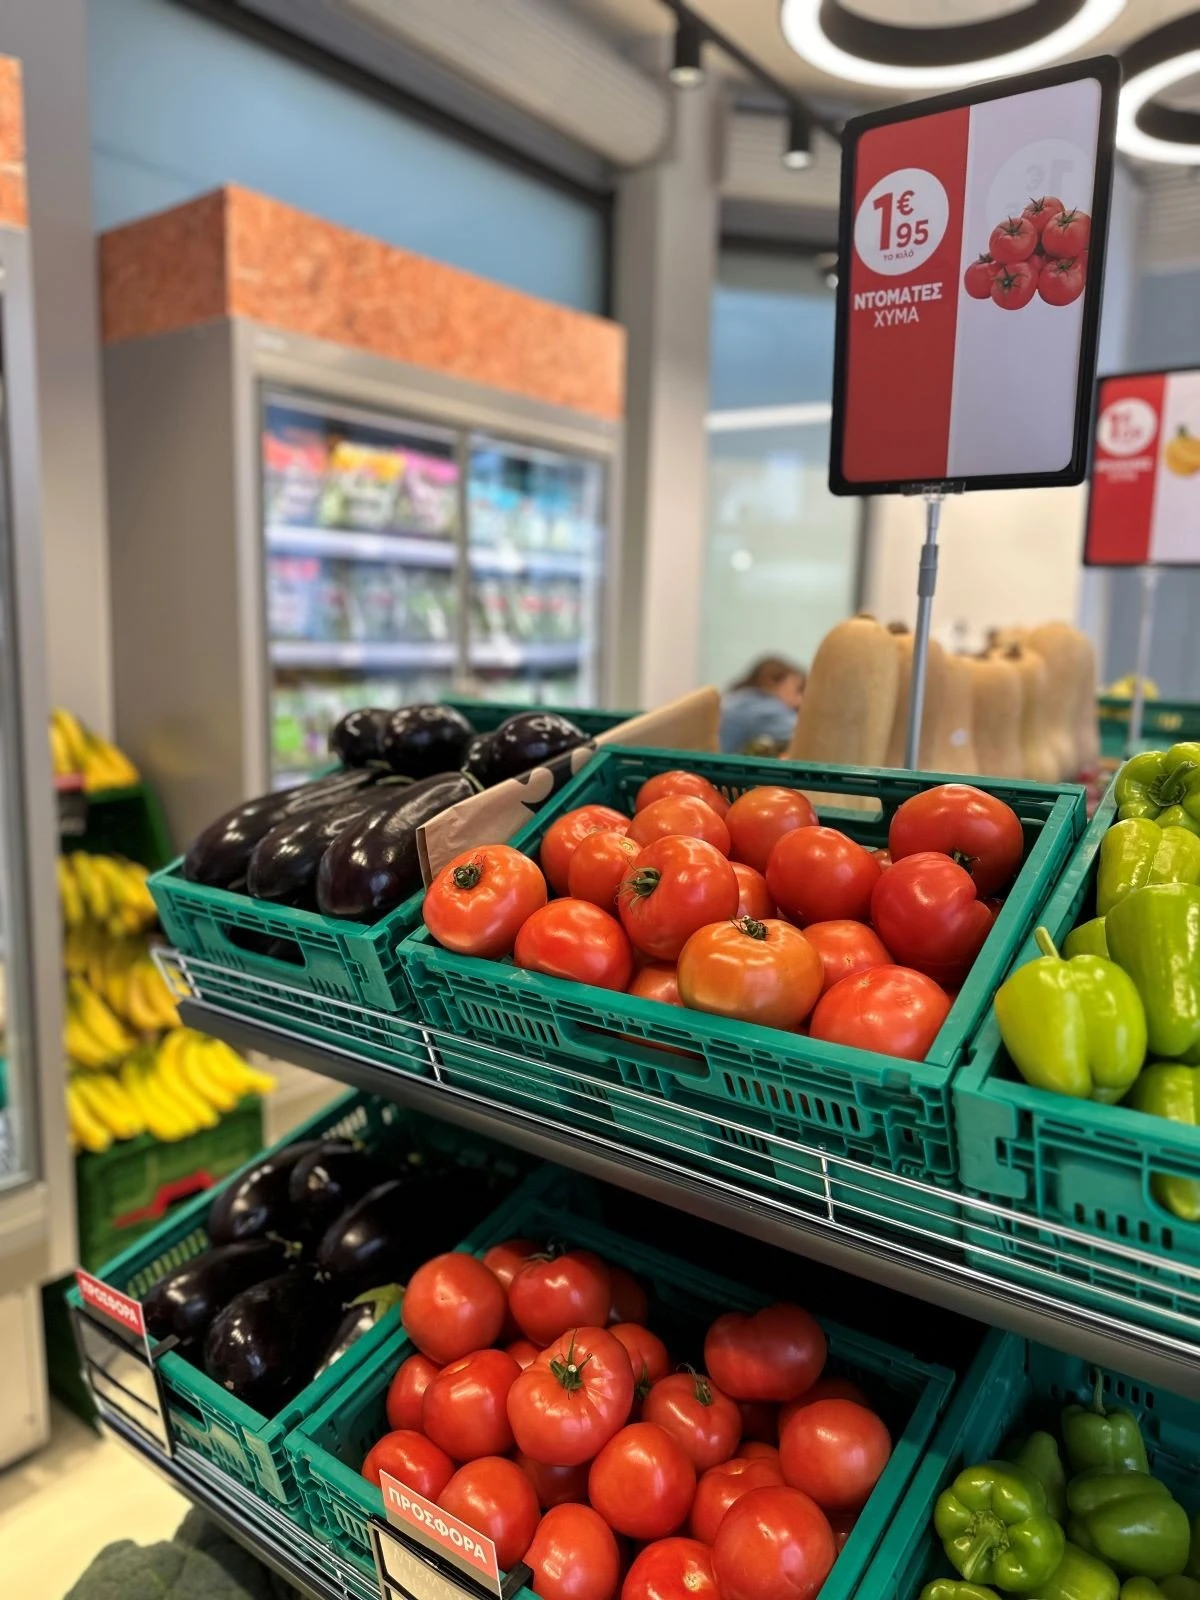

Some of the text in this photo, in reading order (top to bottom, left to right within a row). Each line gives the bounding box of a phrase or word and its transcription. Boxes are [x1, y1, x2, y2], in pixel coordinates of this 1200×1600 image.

[896, 219, 929, 248] 95
[854, 282, 943, 310] ΝΤΟΜΑΤΕΣ
[874, 306, 919, 328] ΧΥΜΑ
[388, 1486, 487, 1564] ΠΡΟΣΦΟΡΑ
